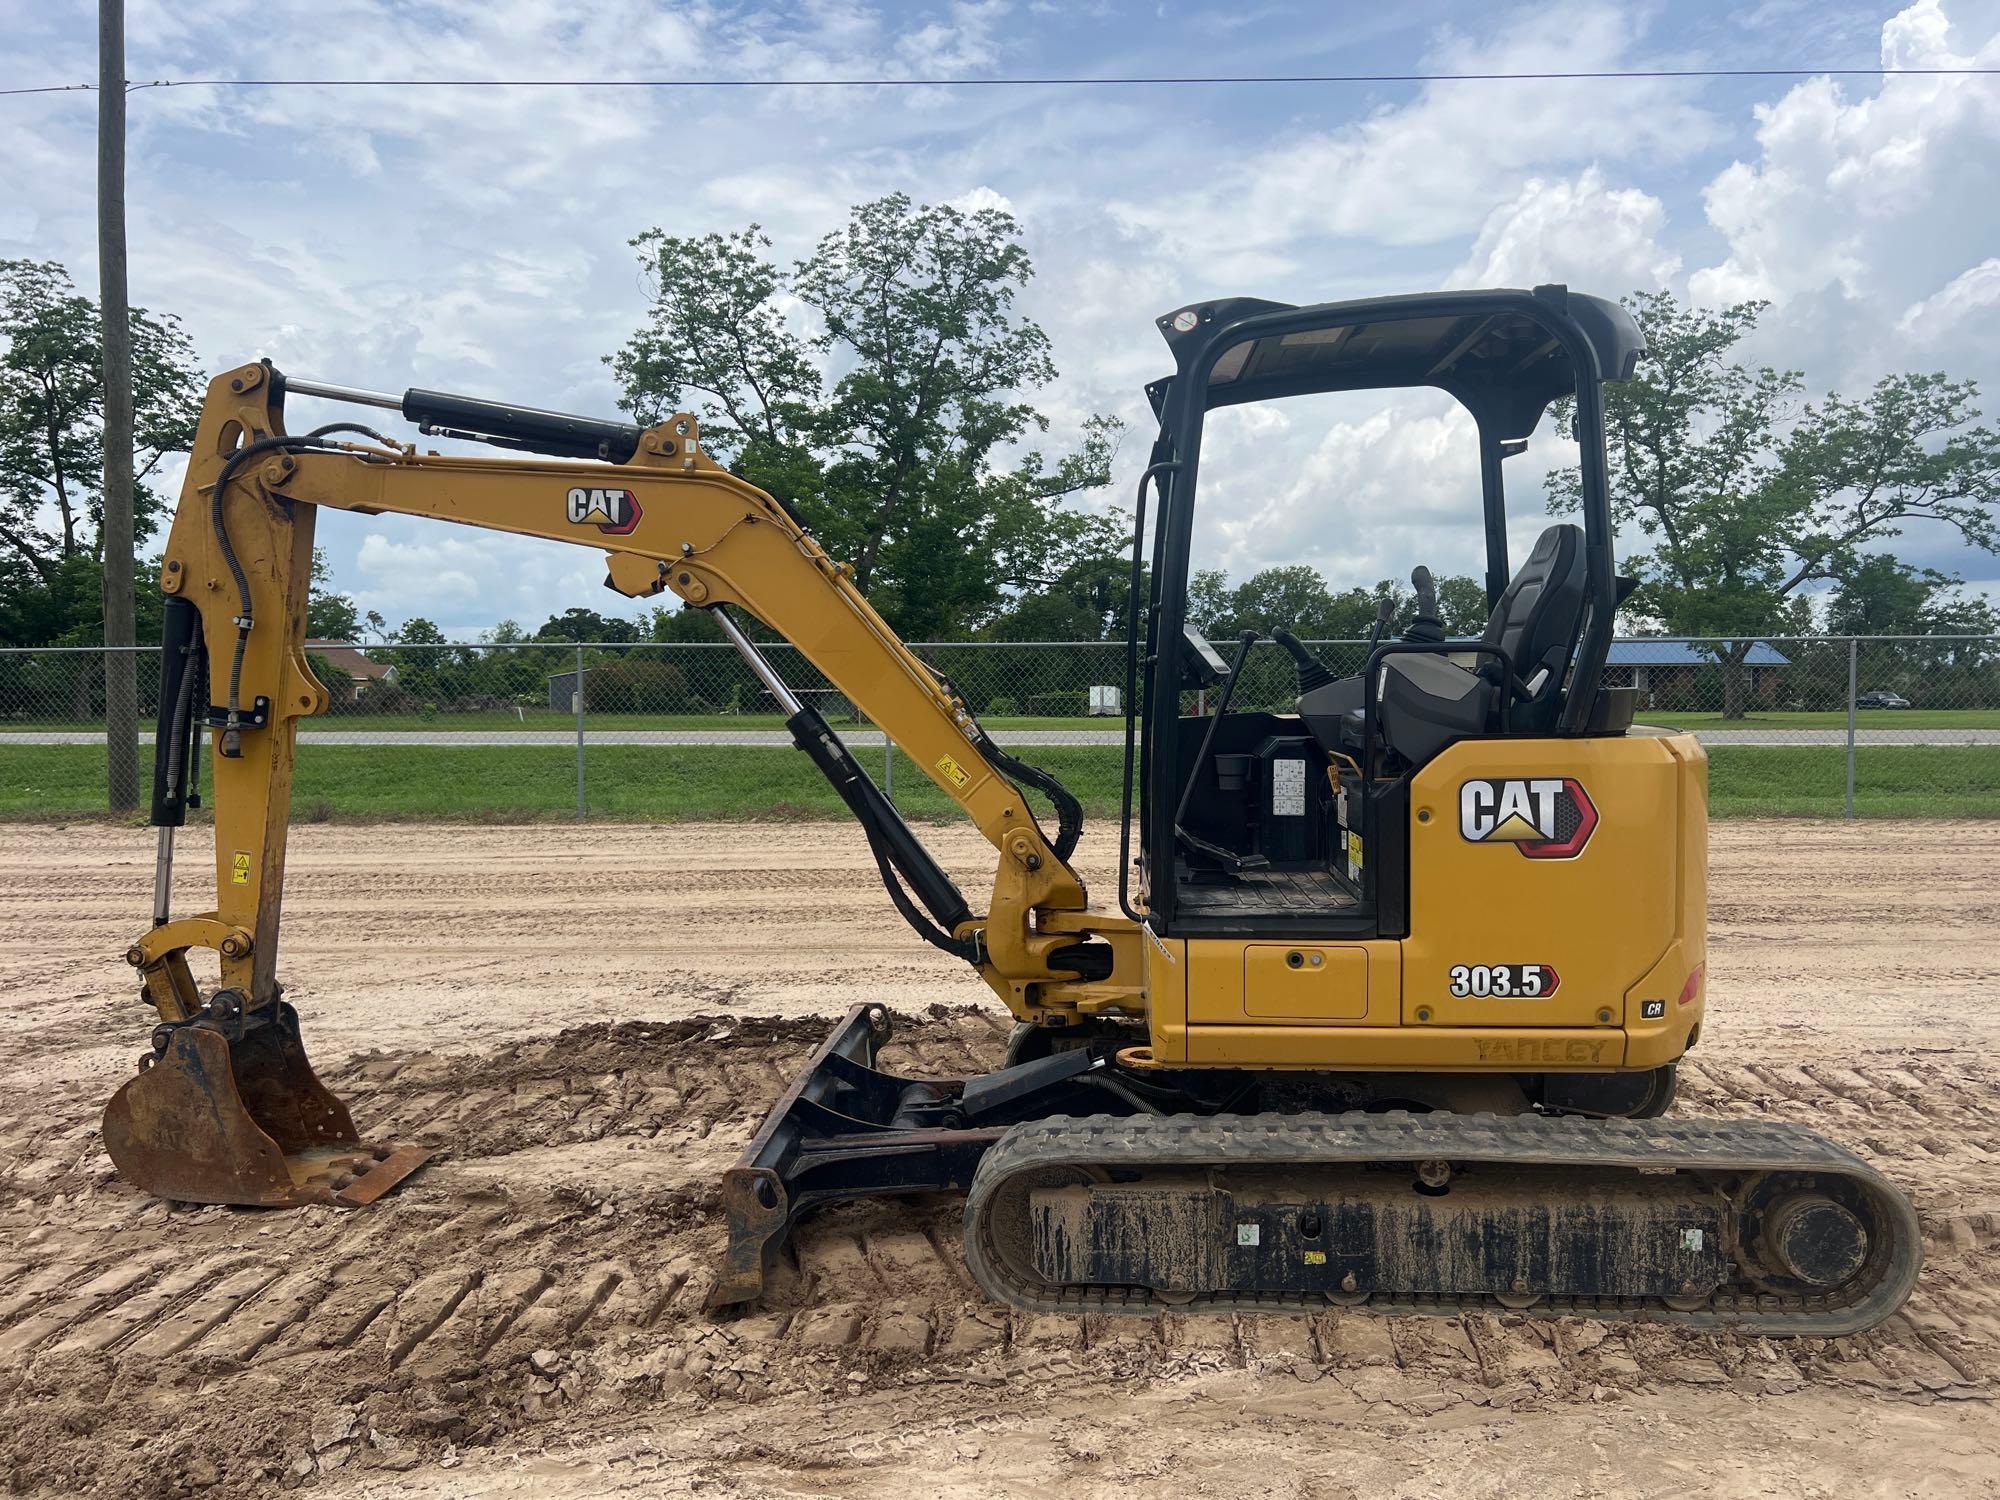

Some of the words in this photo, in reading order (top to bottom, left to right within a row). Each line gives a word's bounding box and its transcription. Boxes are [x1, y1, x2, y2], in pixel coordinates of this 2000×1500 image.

[567, 488, 624, 524] CAT
[1461, 780, 1563, 840] CAT
[1450, 965, 1541, 996] 303.5
[1646, 1002, 1662, 1016] CR
